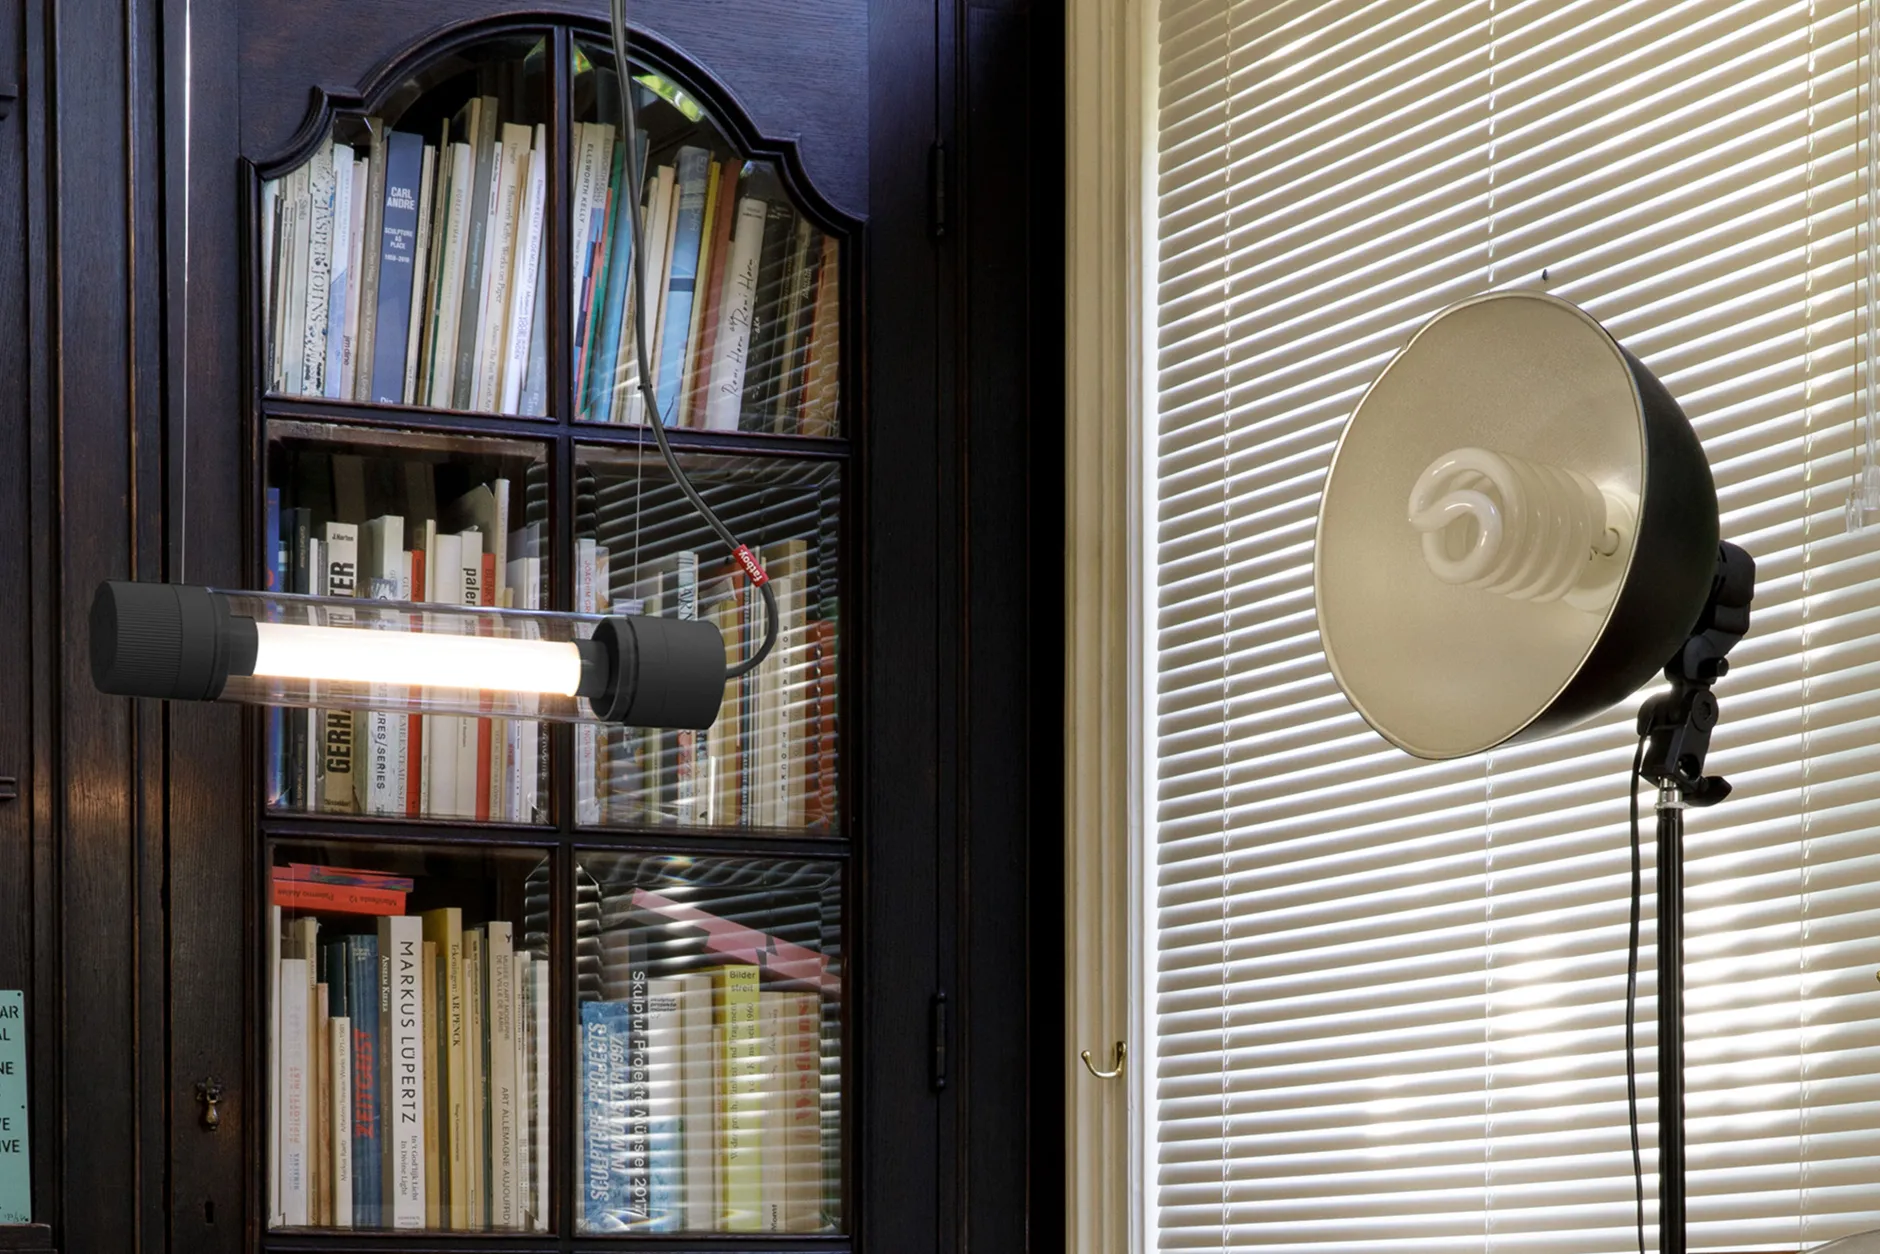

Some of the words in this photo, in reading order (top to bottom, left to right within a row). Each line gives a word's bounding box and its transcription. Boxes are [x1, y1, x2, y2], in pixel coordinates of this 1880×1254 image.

[582, 142, 595, 194] ELLSWORTH
[386, 197, 416, 212] ANDRE
[390, 186, 413, 200] CARL
[503, 184, 516, 221] Ellsworth
[578, 196, 589, 224] KELLY
[312, 202, 330, 261] JASPER
[383, 226, 413, 238] SCULPTURE
[532, 207, 542, 229] KELLY
[389, 241, 407, 250] PLACE
[310, 266, 327, 322] JOHNS
[495, 282, 506, 304] Paper
[726, 336, 744, 363] Horn
[737, 258, 754, 292] Horn
[584, 560, 592, 598] JOACHIM
[382, 955, 390, 985] ANSELM
[400, 941, 415, 1028] MARKUS
[450, 943, 460, 993] Tekeningen:
[729, 971, 756, 979] Bilder
[382, 986, 390, 1012] KIEFER
[631, 971, 646, 1036] Skulptur
[731, 984, 754, 992] streit
[0, 1005, 19, 1019] AR
[452, 1013, 461, 1046] PENCK
[401, 1036, 417, 1124] LÜPERTZ
[587, 1022, 608, 1104] PROJECTS
[632, 1040, 646, 1104] Projekte
[352, 1027, 374, 1139] ZEITGEIST
[501, 1086, 509, 1105] ART
[0, 1117, 11, 1131] E
[501, 1107, 510, 1167] ALLEMAGNE
[633, 1109, 648, 1174] Münster
[589, 1108, 610, 1201] SCULPTURE
[611, 1152, 626, 1172] IN
[399, 1175, 407, 1196] Light
[634, 1178, 647, 1218] 2017
